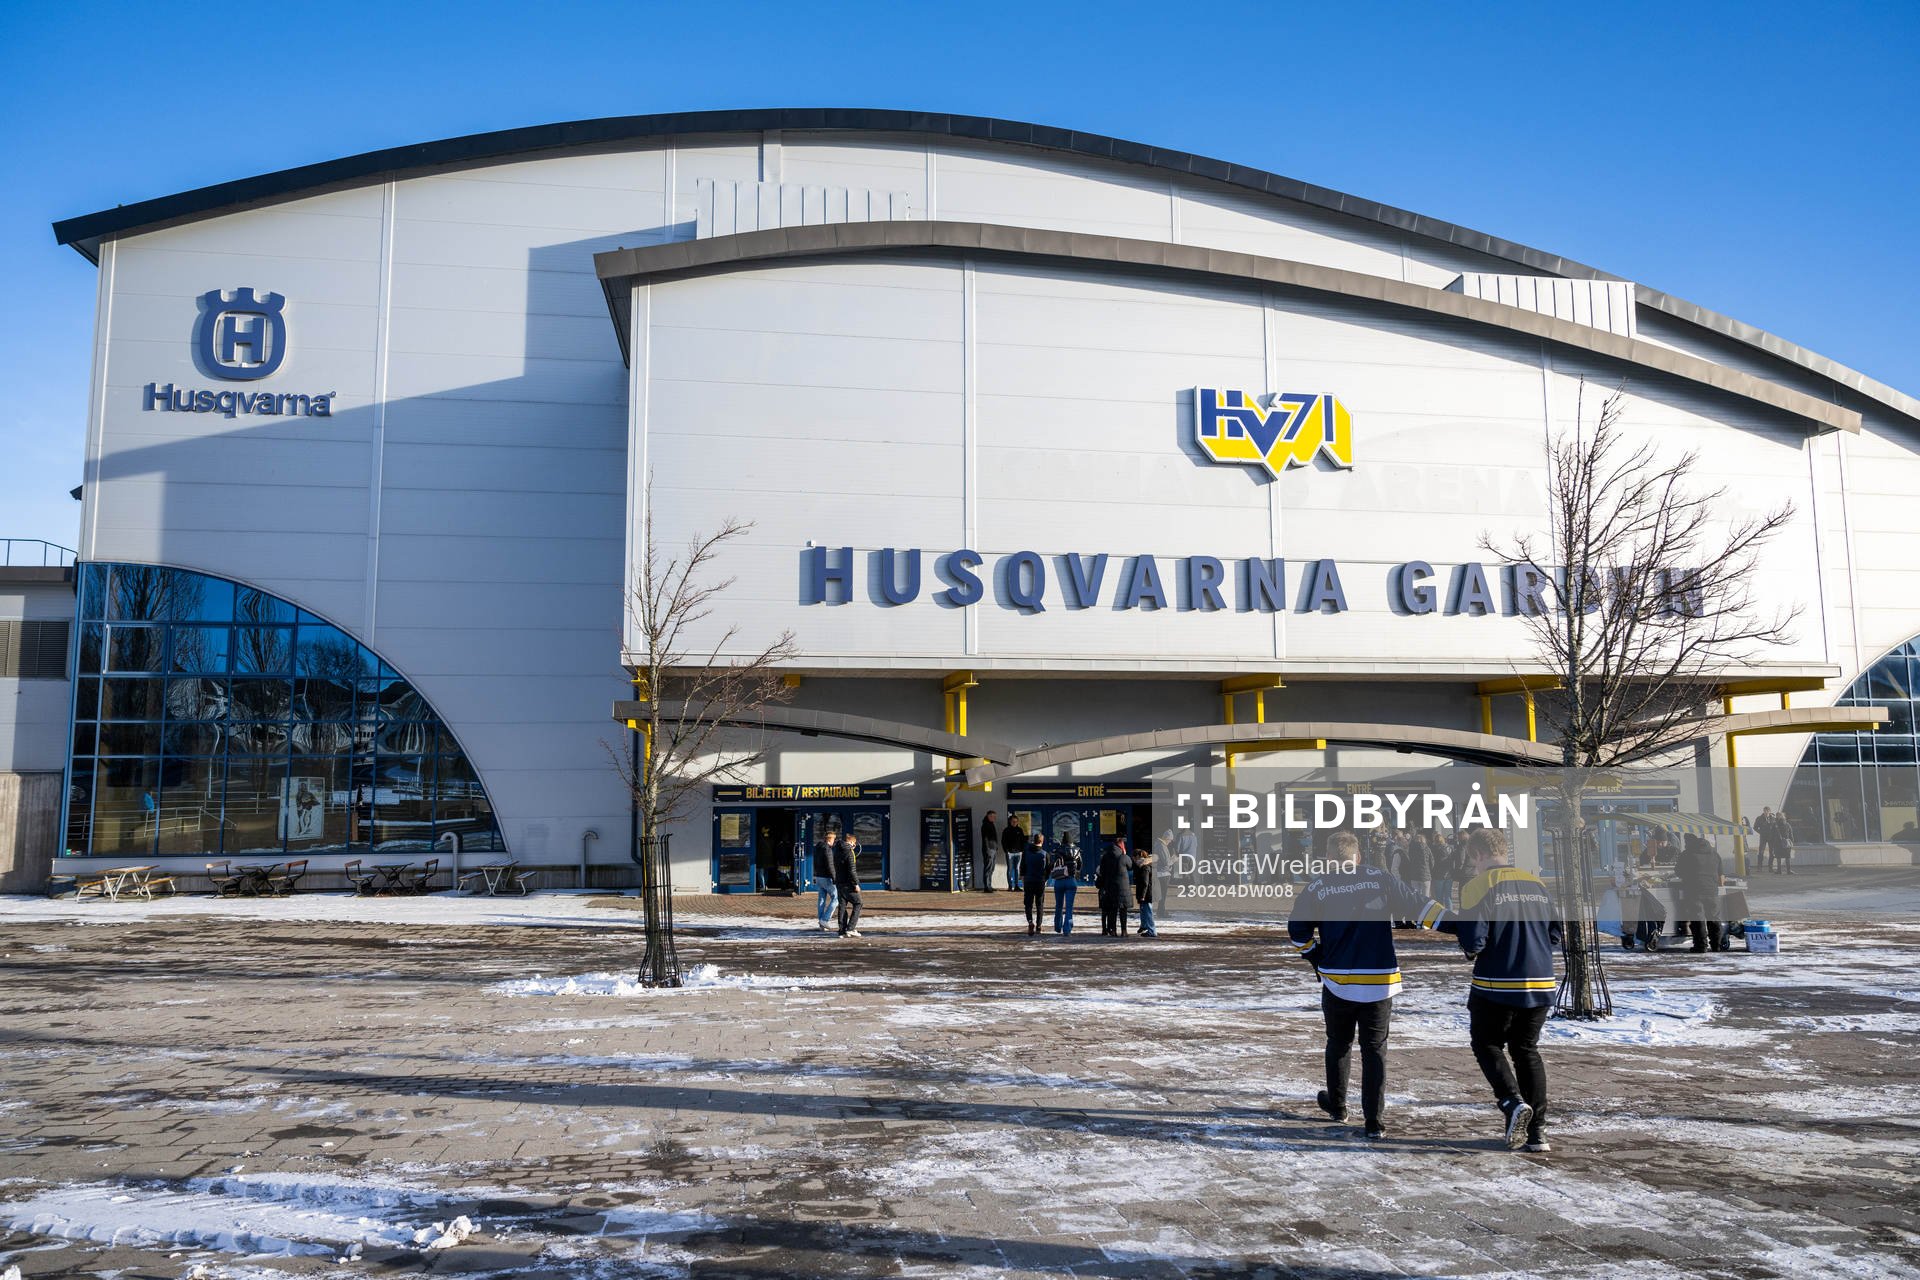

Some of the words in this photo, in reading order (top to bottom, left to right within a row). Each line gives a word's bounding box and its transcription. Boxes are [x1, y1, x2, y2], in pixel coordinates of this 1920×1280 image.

[148, 382, 333, 418] Husqvarna
[812, 545, 1349, 612] HUSQVARNA
[1400, 560, 1704, 618] GARDEN
[746, 787, 793, 799] BILJETTER
[802, 786, 860, 798] RESTAURANG
[1077, 784, 1105, 797] ENTRÉ
[1347, 781, 1372, 795] ENTRÉ
[1325, 880, 1381, 896] Husqvarna
[1501, 892, 1549, 904] Husqvarna
